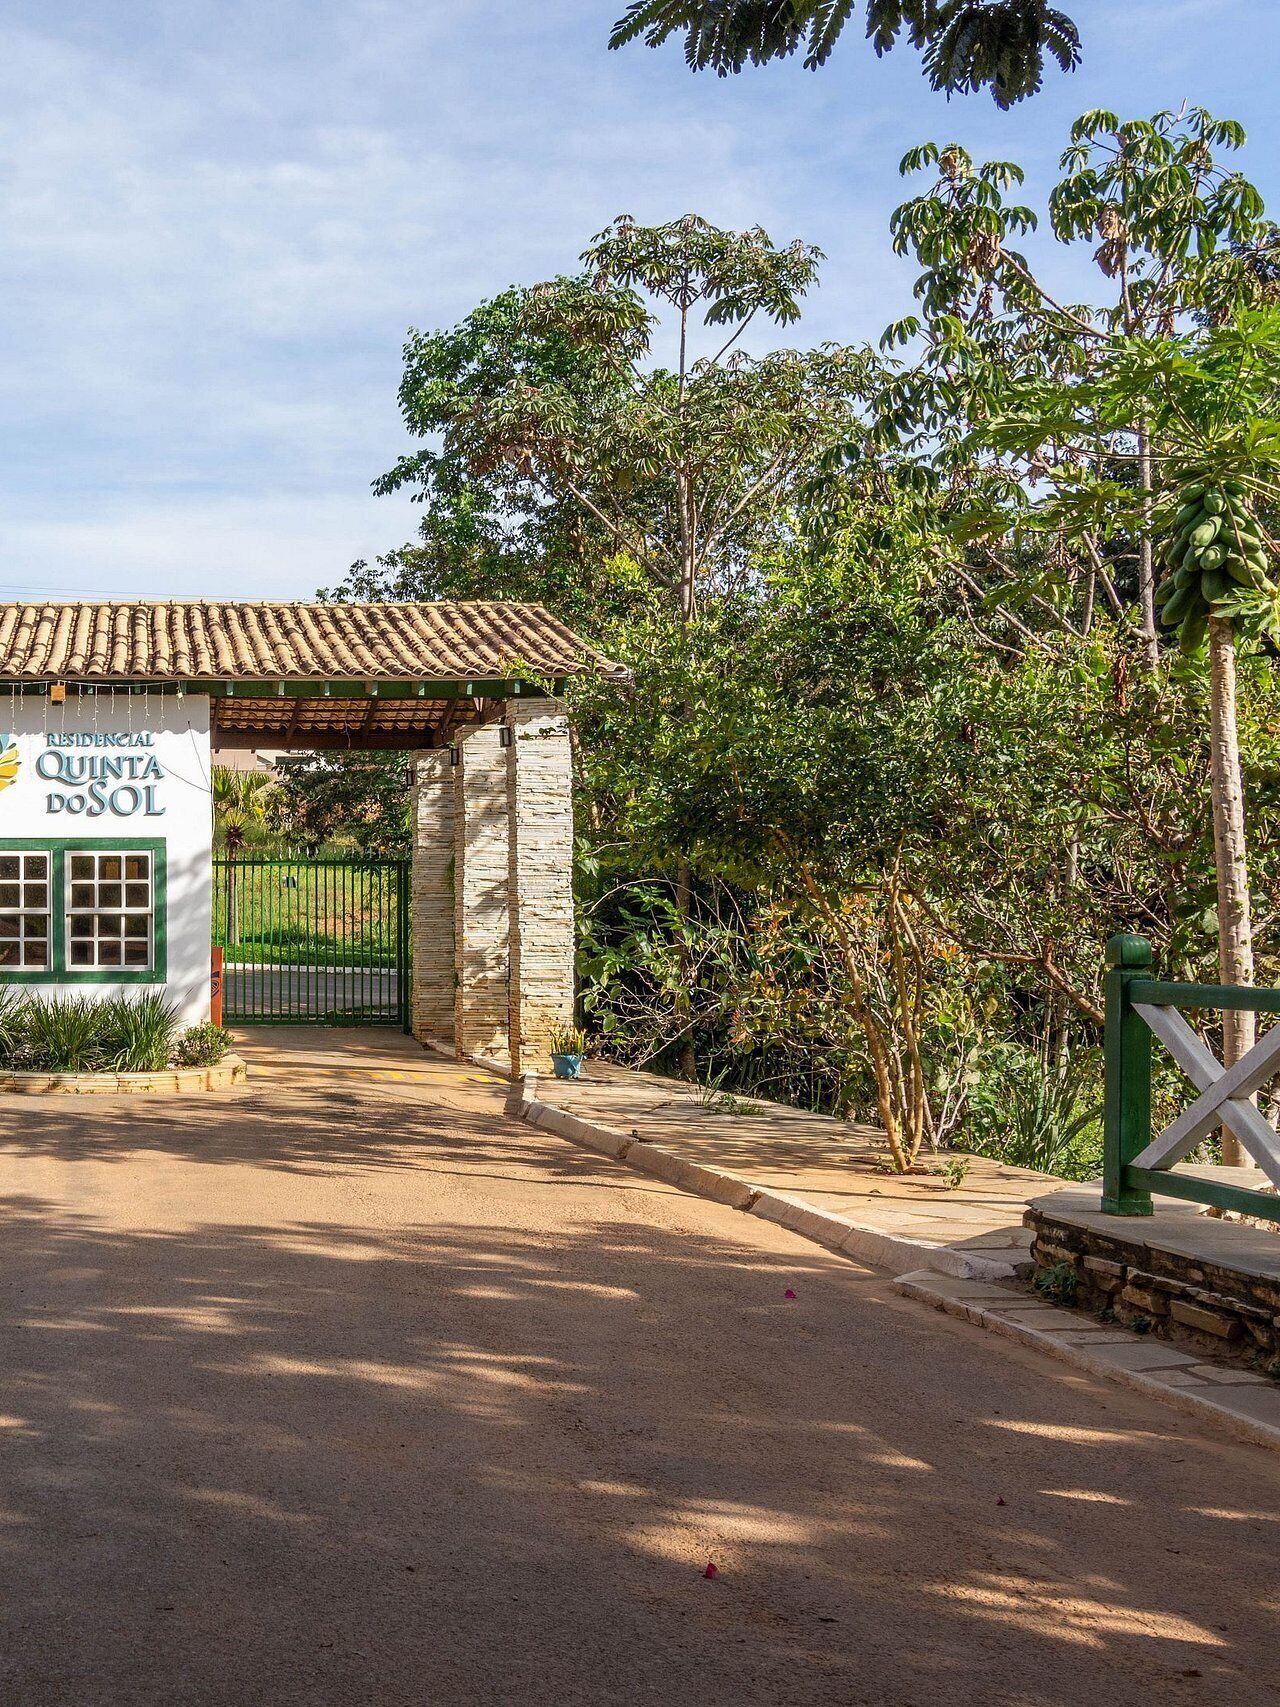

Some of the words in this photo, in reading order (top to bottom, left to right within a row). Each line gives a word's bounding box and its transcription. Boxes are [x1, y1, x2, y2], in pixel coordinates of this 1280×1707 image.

[46, 732, 155, 747] RESIDENCIAL
[35, 749, 165, 787] QUINTA
[87, 778, 166, 817] SOL
